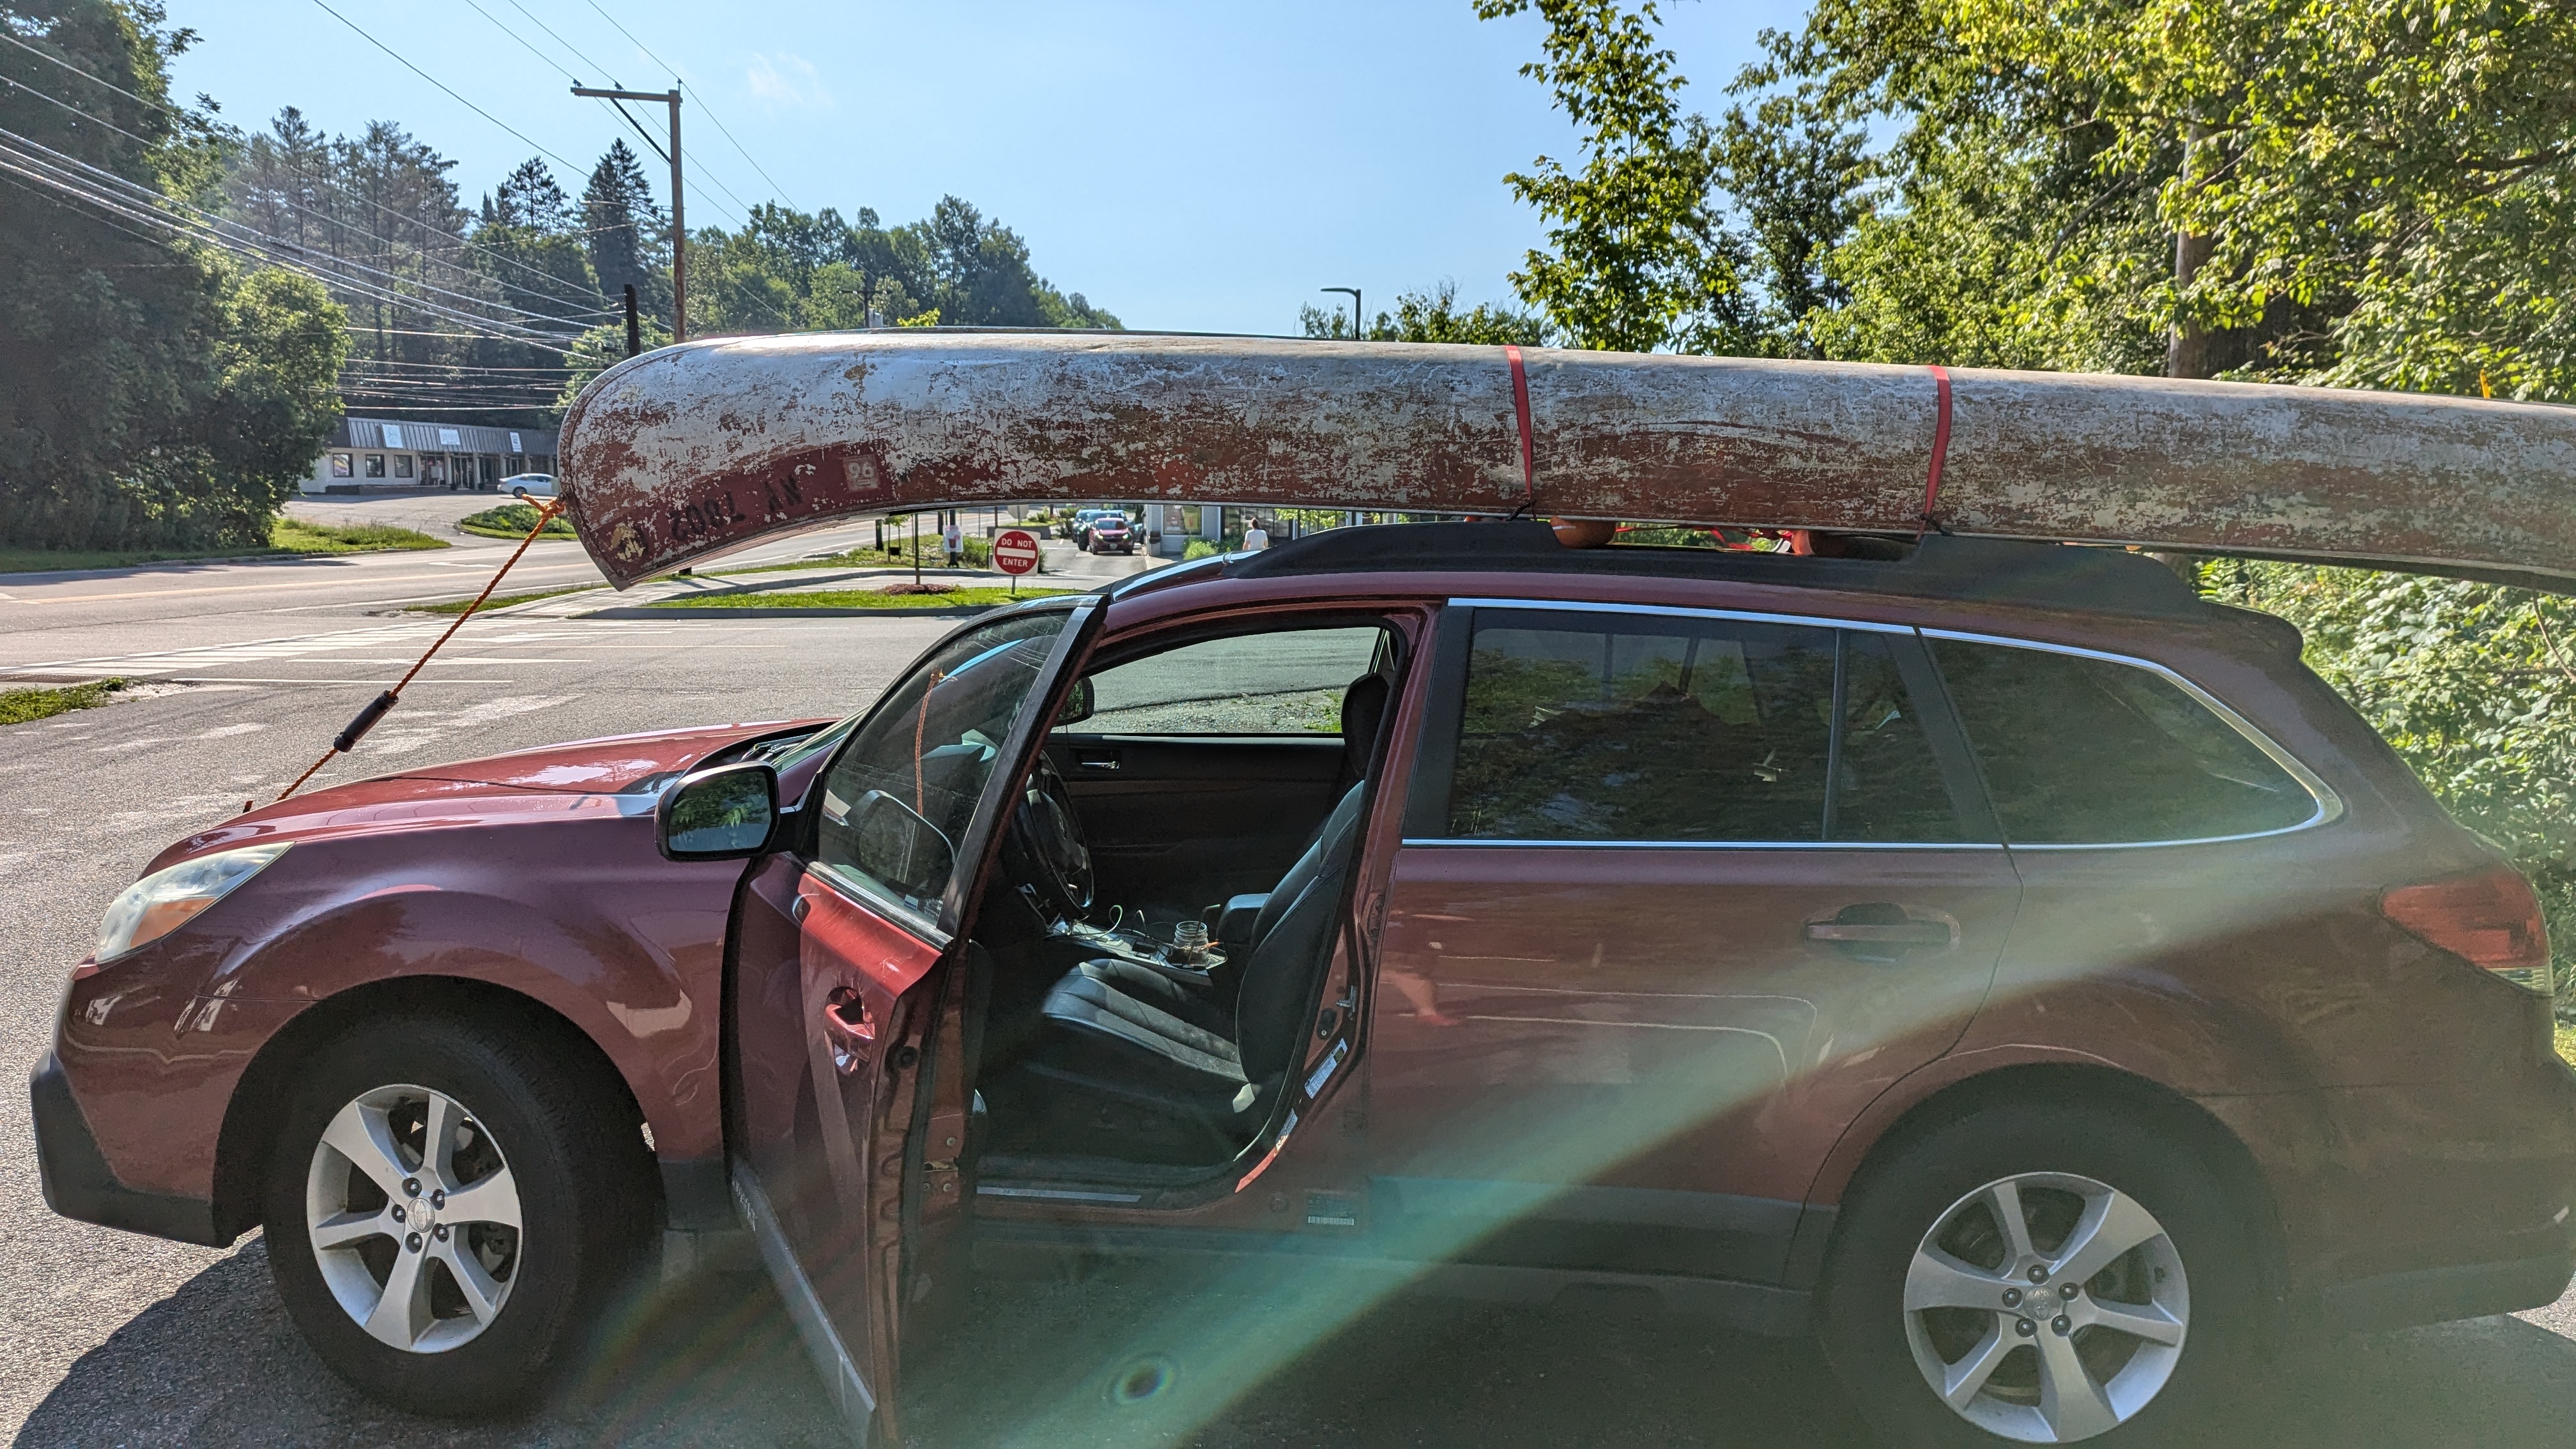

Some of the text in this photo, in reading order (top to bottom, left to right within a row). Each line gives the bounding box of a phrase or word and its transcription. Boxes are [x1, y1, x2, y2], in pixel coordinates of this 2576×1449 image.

[848, 461, 875, 479] 96
[1018, 540, 1032, 548] NOT
[1003, 558, 1028, 567] ENTER
